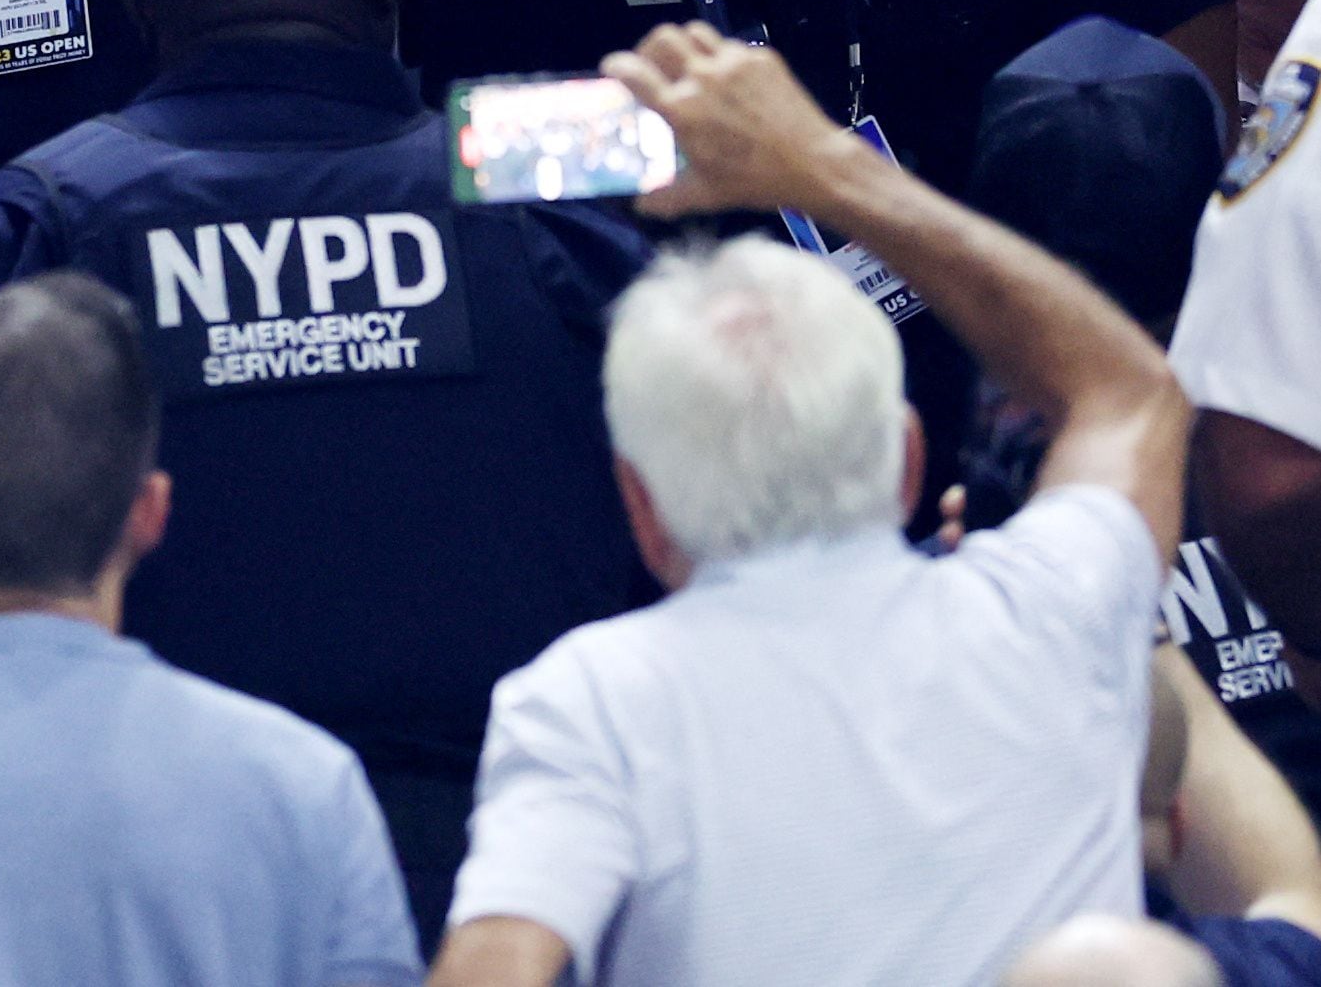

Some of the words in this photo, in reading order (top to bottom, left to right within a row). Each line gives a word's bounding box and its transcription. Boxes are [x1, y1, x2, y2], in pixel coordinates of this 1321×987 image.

[14, 44, 37, 58] US
[41, 35, 85, 53] OPEN
[146, 212, 447, 328] NYPD
[883, 293, 908, 313] US
[207, 311, 406, 354] EMERGENCY
[203, 344, 345, 387] SERVICE
[348, 337, 420, 372] UNIT
